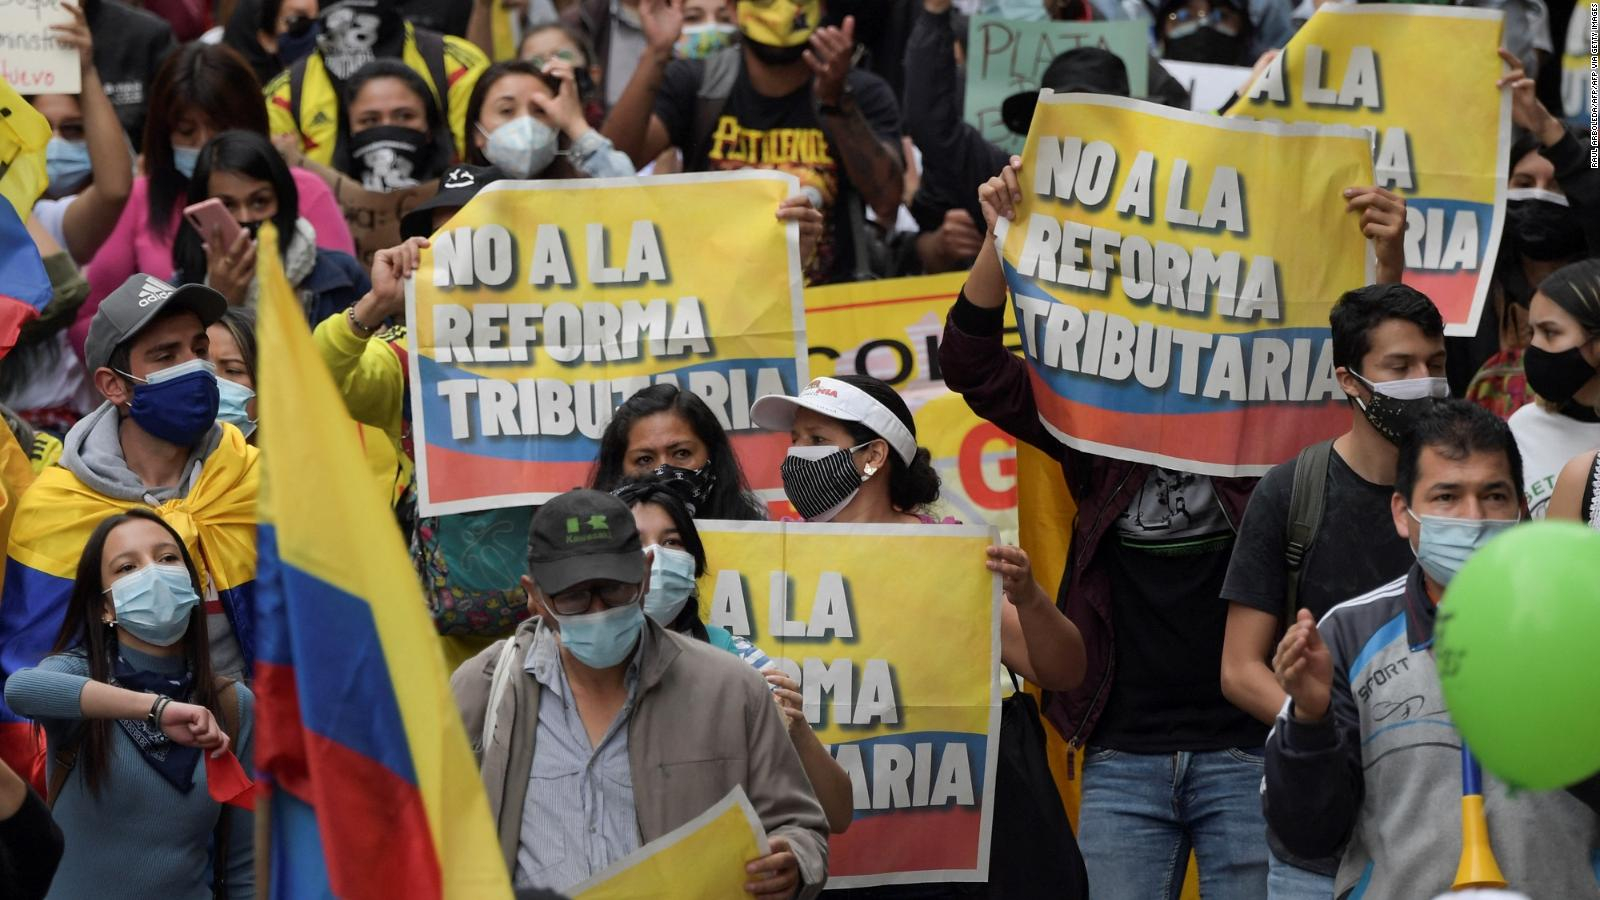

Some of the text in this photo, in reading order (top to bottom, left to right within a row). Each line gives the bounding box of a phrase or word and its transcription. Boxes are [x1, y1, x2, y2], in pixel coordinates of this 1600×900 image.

[1302, 44, 1380, 108] LA
[1034, 135, 1244, 233] NO A LA
[432, 219, 666, 287] NO A LA
[1016, 212, 1280, 319] REFORMA
[432, 295, 711, 364] REFORMA
[1014, 292, 1349, 402] TRIBUTARIA
[709, 569, 854, 638] A LA
